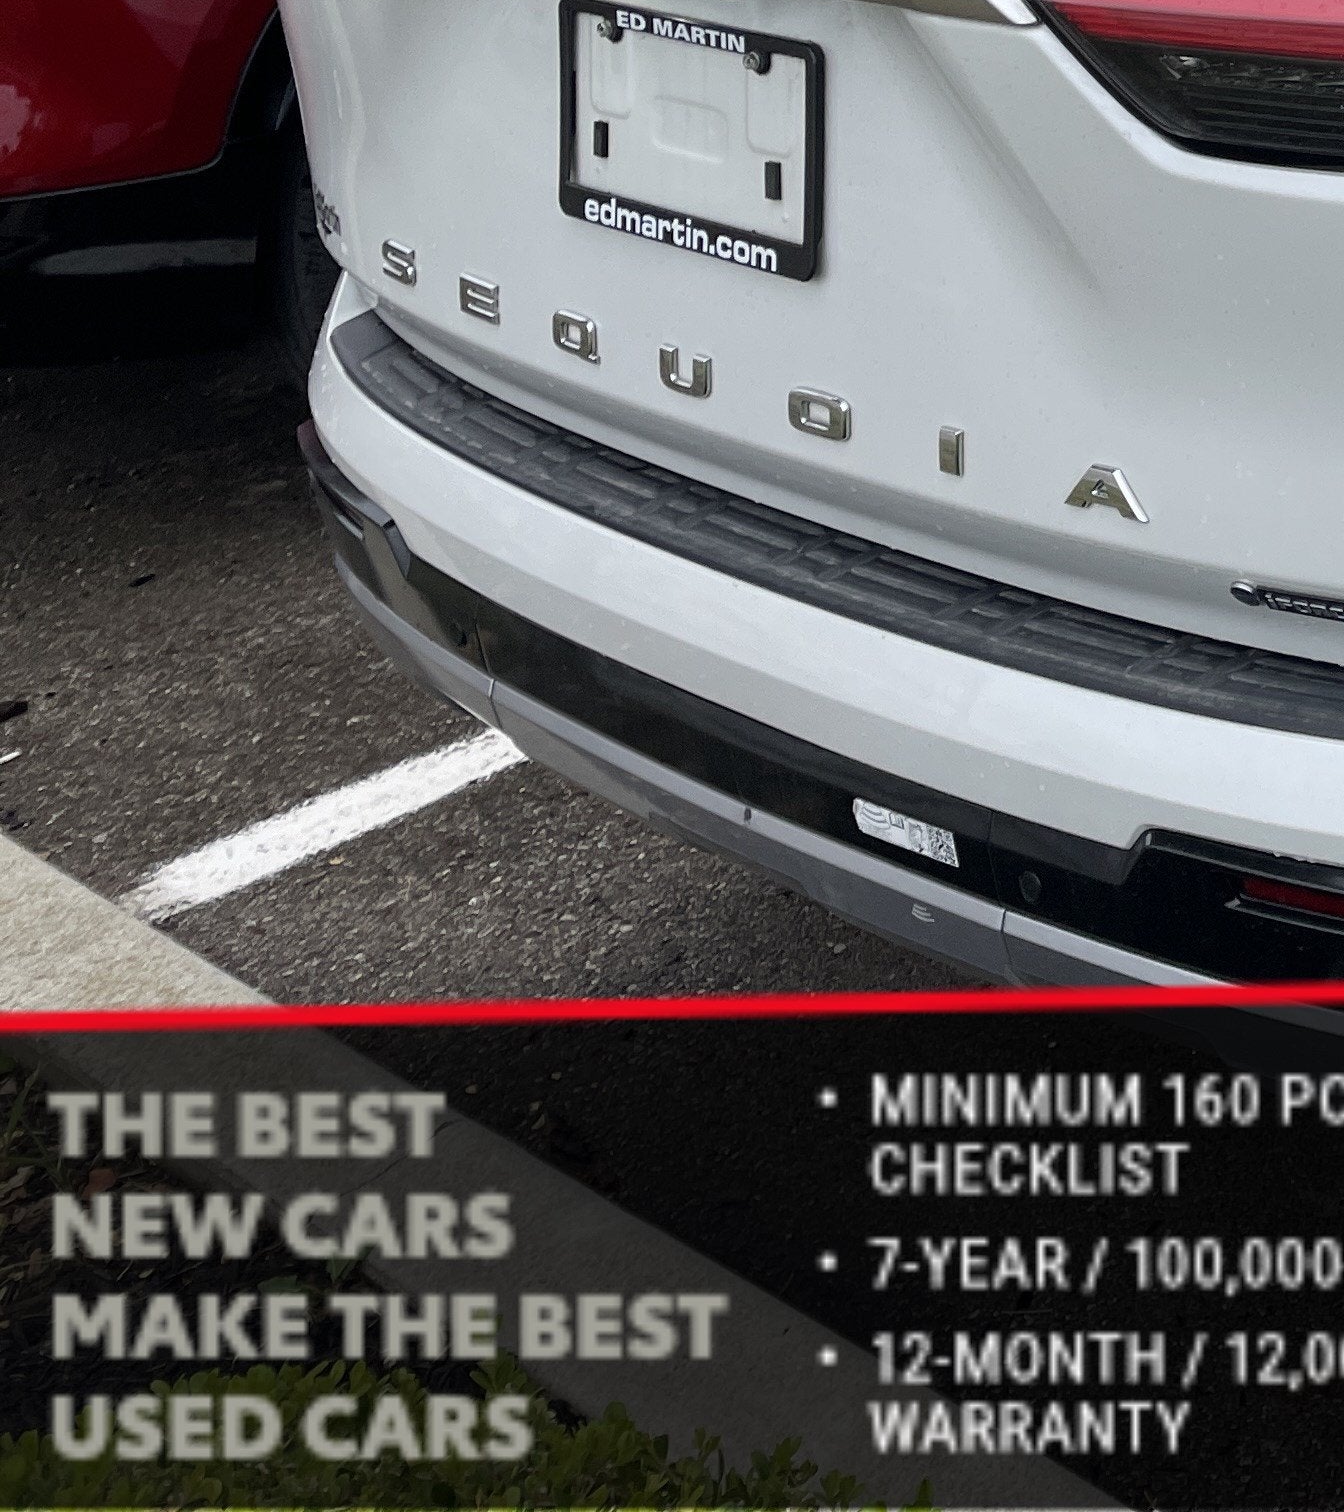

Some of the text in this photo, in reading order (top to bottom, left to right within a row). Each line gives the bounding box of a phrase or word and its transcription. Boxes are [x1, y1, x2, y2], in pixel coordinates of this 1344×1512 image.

[616, 9, 745, 53] ED MARTIN
[584, 197, 777, 272] edmartin.com
[382, 238, 1151, 524] SEQUOIA
